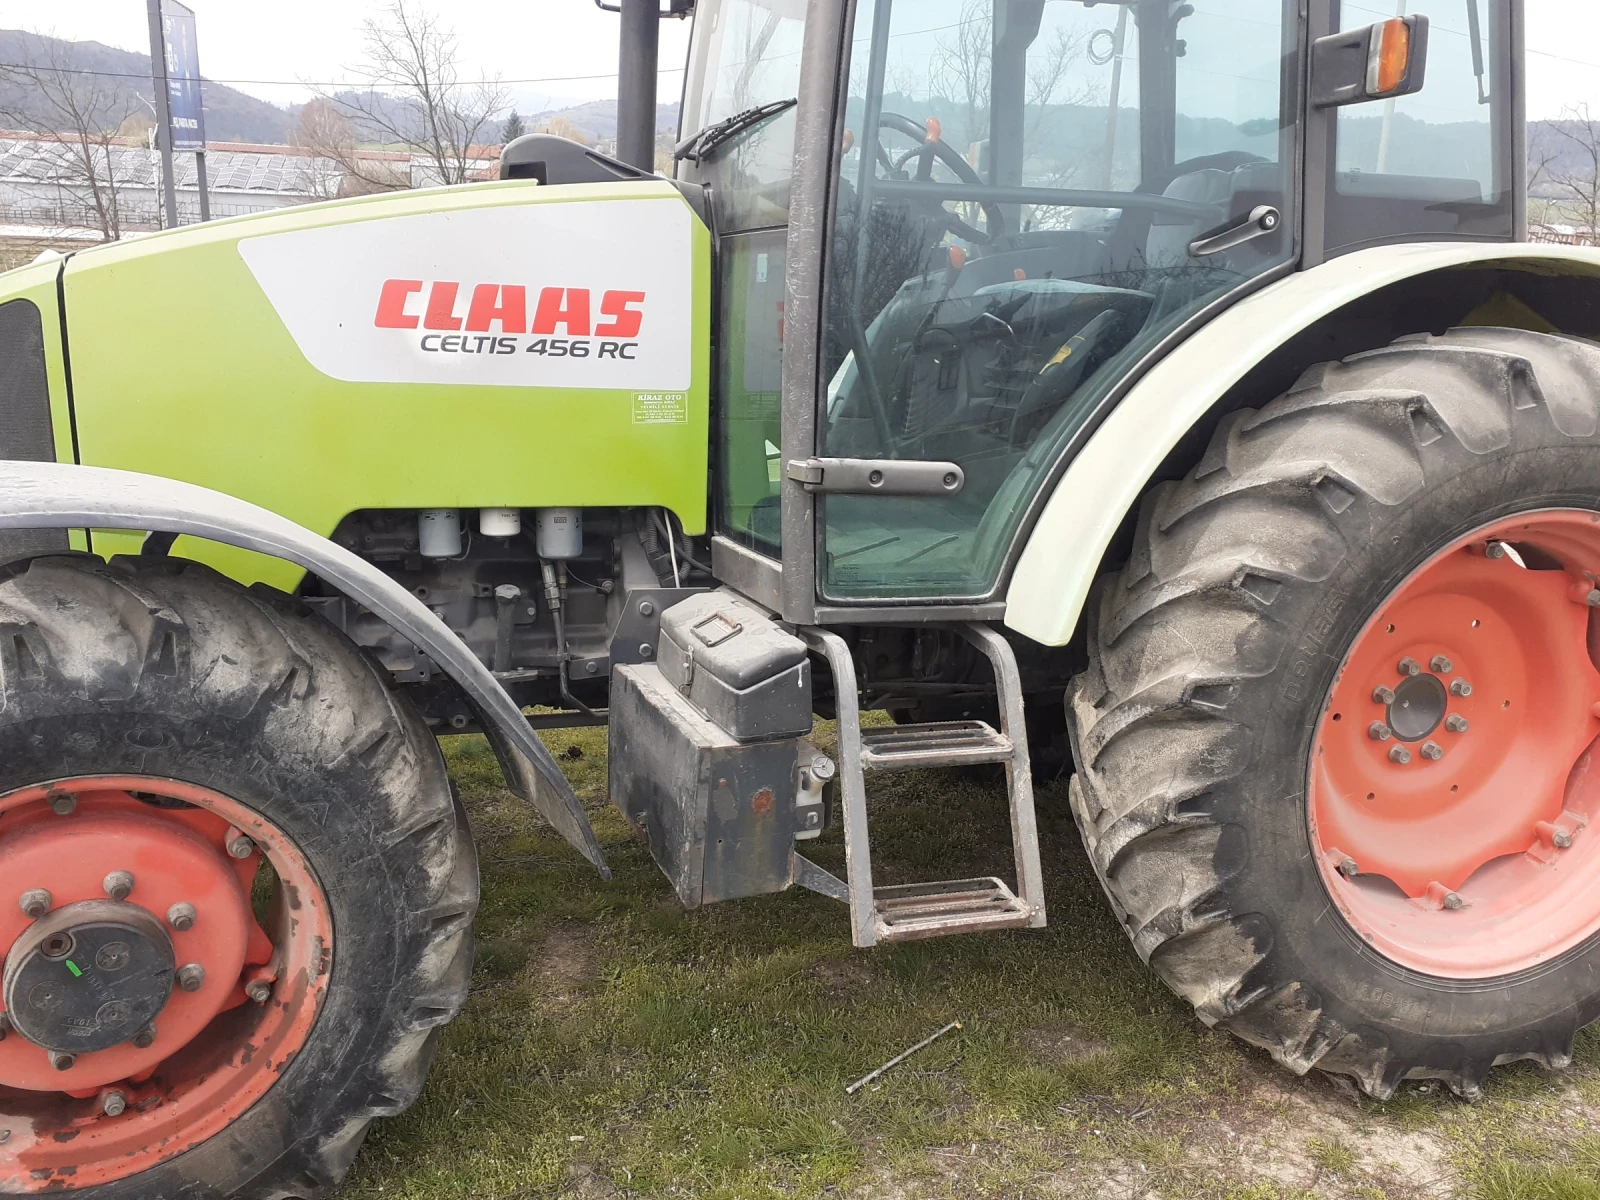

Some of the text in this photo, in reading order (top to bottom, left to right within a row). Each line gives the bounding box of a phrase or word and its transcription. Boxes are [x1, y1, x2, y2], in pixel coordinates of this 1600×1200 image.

[374, 278, 646, 338] CLAAS
[420, 334, 639, 360] CELTIS 456 RC
